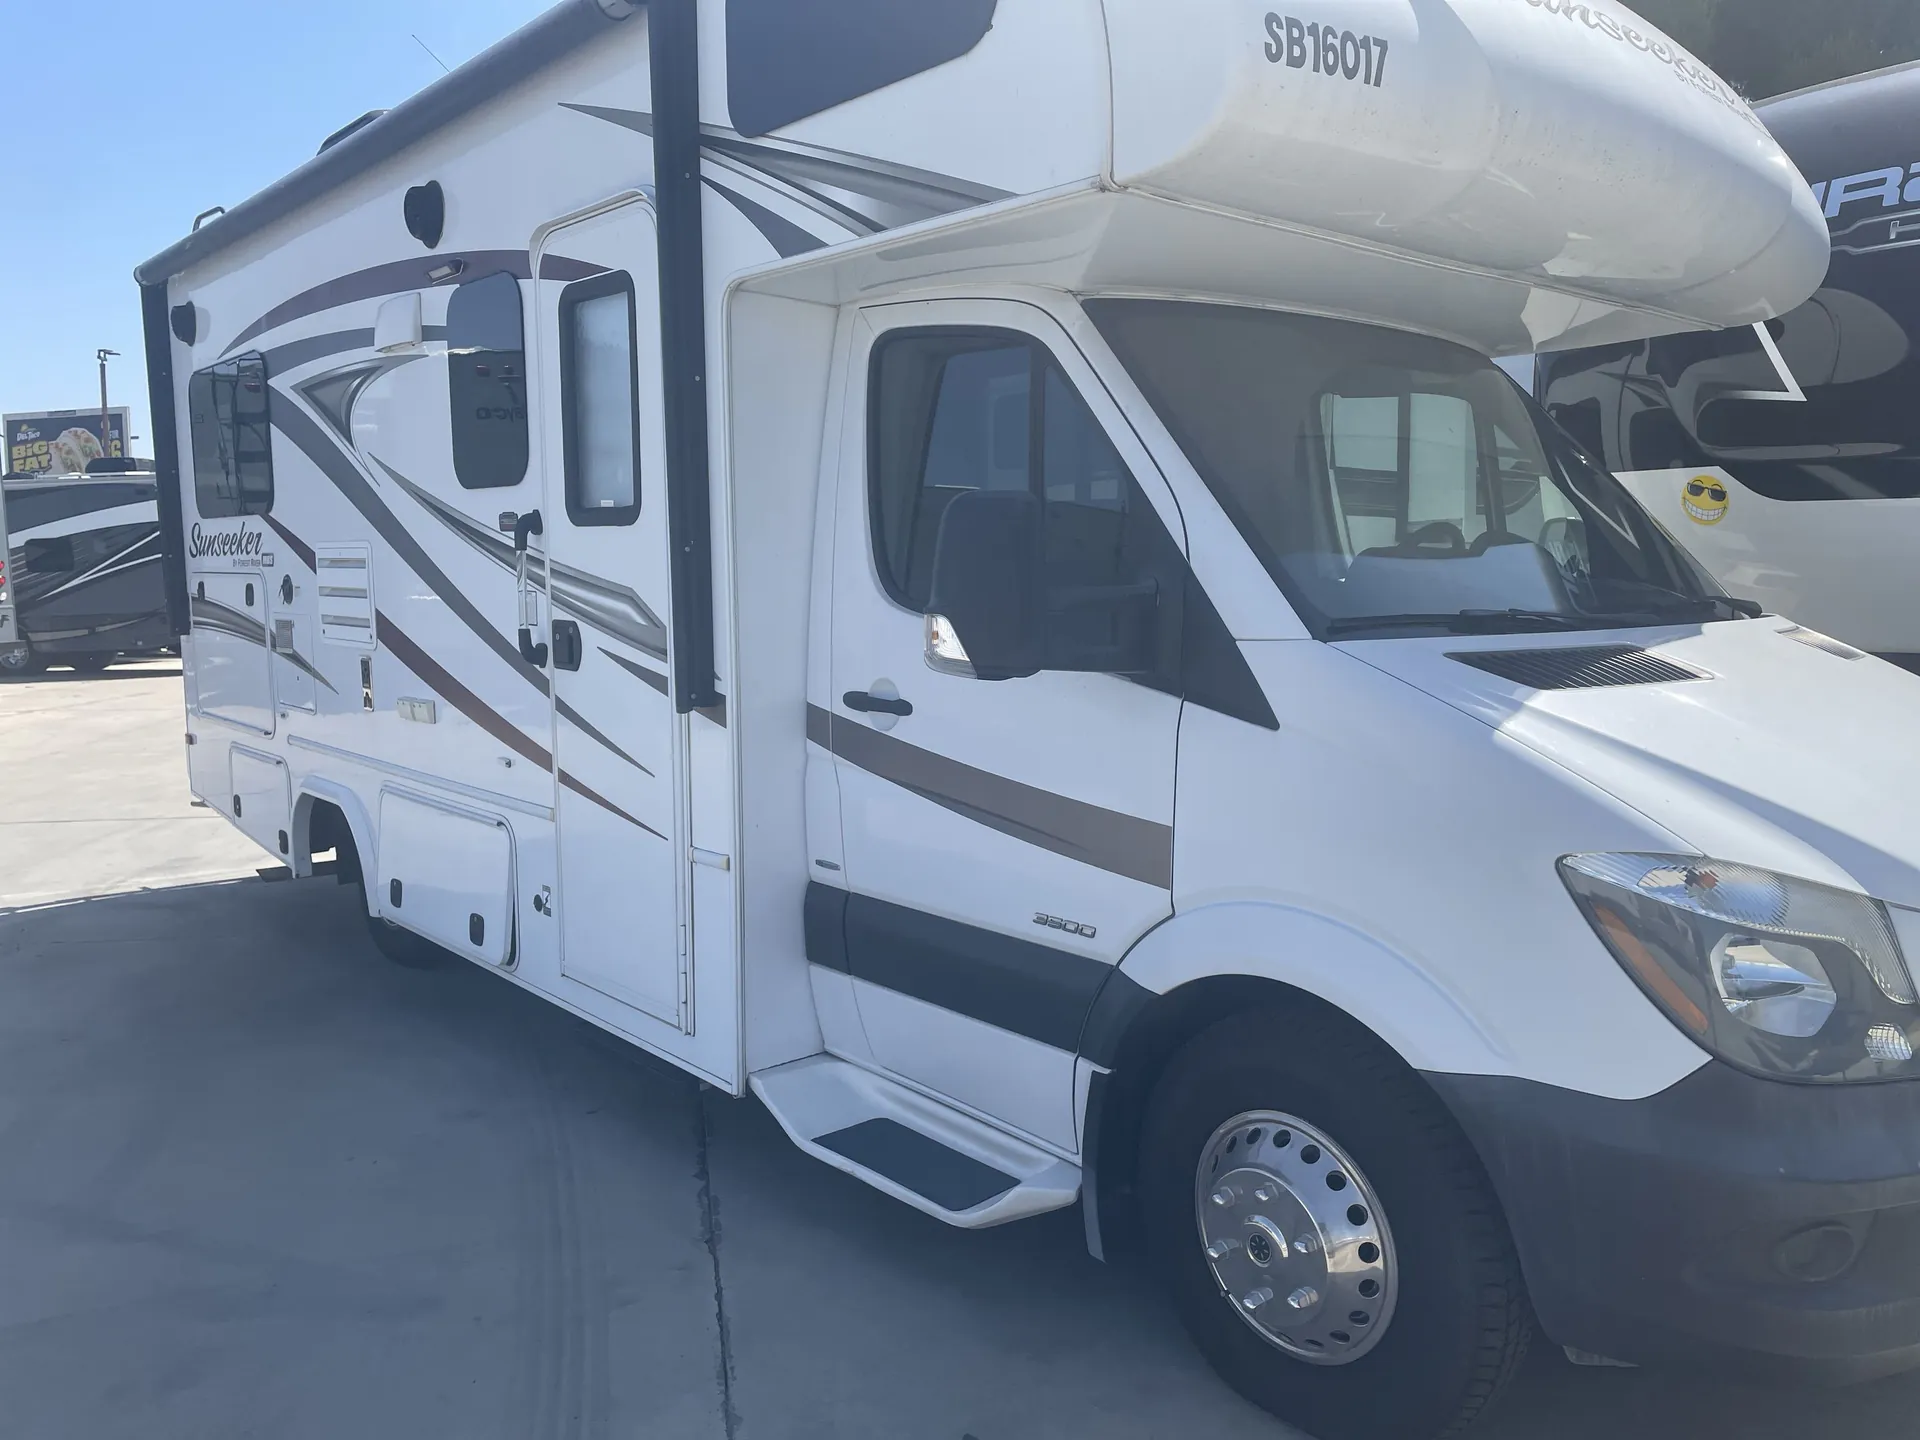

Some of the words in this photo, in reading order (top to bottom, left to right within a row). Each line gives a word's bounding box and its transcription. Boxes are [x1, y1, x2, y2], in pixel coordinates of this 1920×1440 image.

[1264, 12, 1388, 87] SB16017
[1526, 0, 1735, 105] unseeker
[13, 455, 50, 473] FAT
[189, 521, 263, 558] Sunseeker
[1032, 912, 1096, 939] 3500
